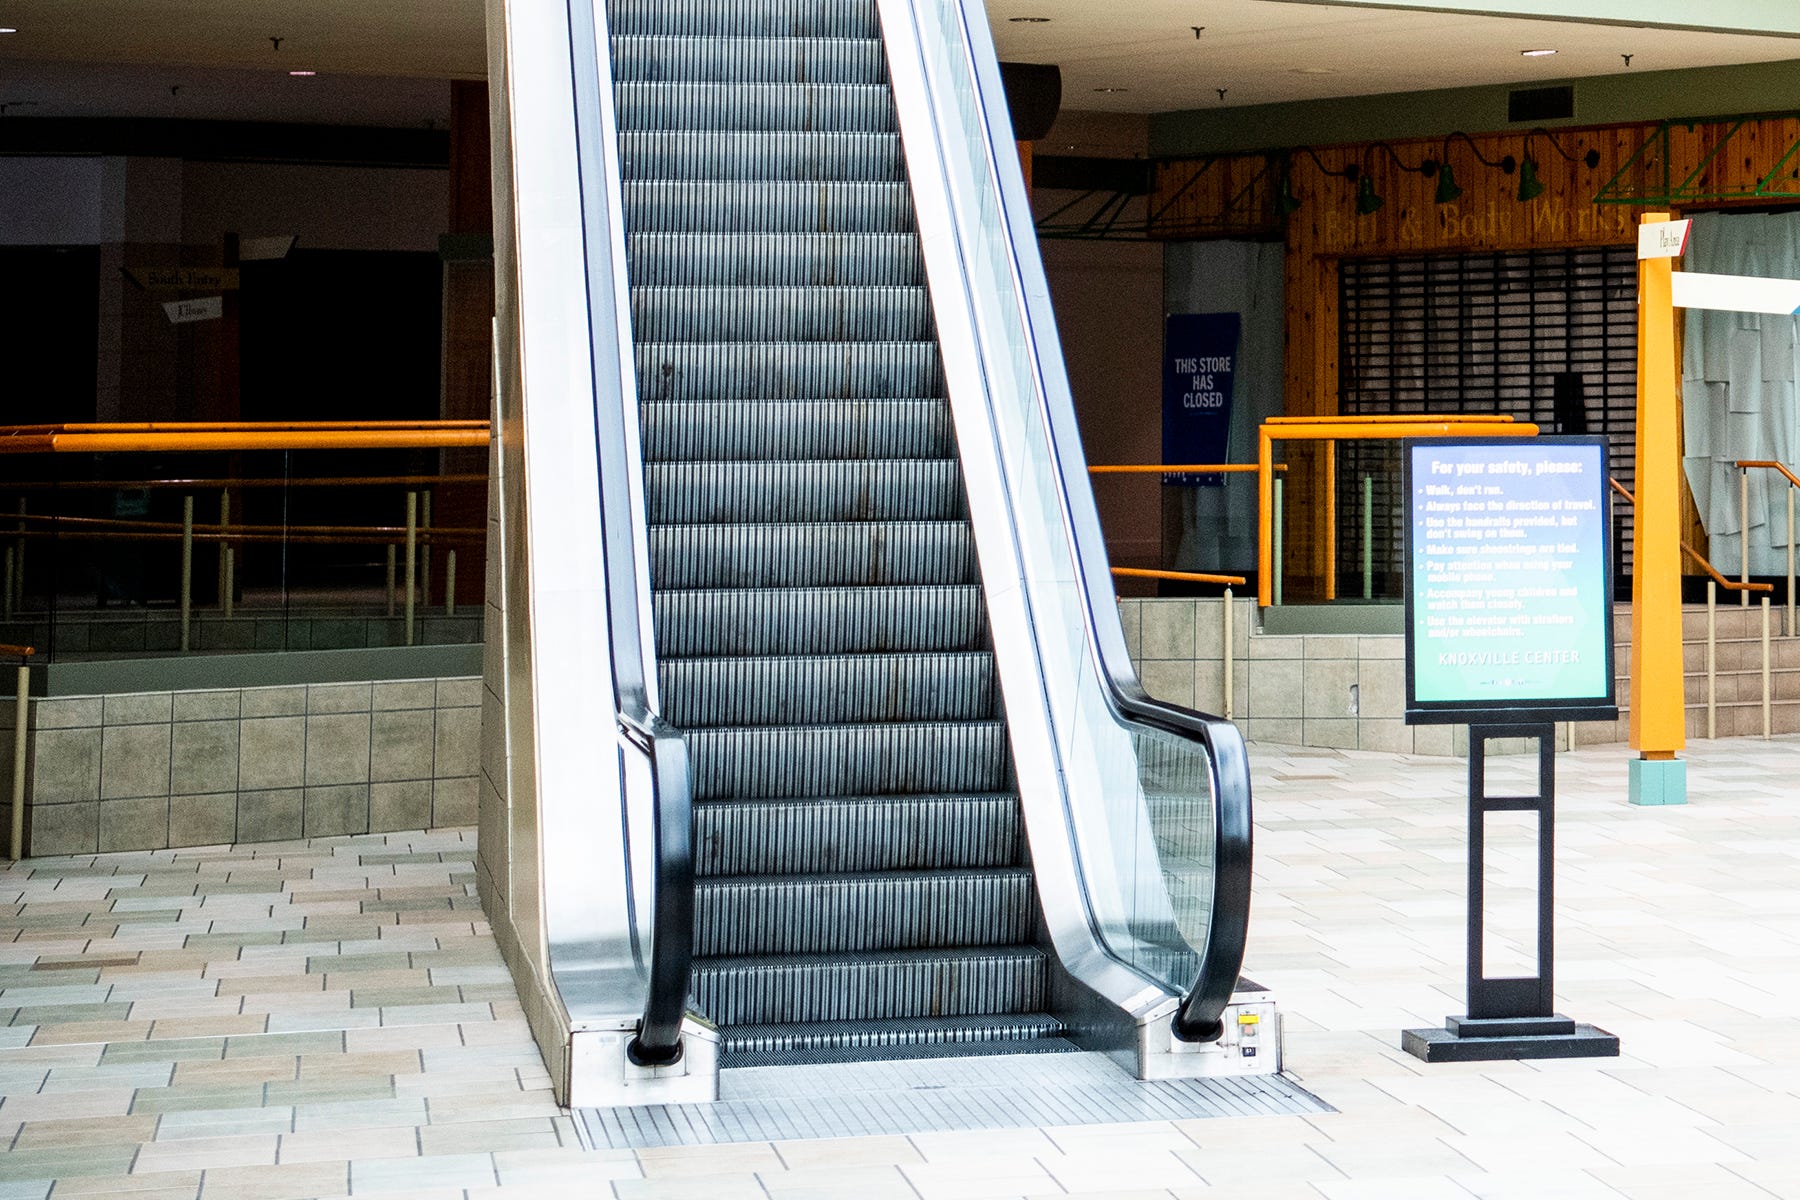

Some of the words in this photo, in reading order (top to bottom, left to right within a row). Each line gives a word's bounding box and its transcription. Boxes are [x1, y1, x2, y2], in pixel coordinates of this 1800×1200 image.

[1175, 359, 1197, 374] THIS
[1199, 356, 1232, 373] STORE
[1192, 375, 1214, 391] HAS
[1183, 392, 1223, 408] CLOSED
[1431, 460, 1454, 474] For
[1456, 463, 1484, 476] your
[1488, 460, 1532, 476] safety,
[1536, 460, 1583, 476] please:
[1426, 484, 1454, 496] Walk,
[1456, 485, 1482, 495] don't
[1426, 501, 1461, 513] Always
[1488, 500, 1503, 511] the
[1506, 500, 1550, 511] direction
[1551, 499, 1562, 510] of
[1426, 517, 1444, 528] Use
[1447, 516, 1463, 527] the
[1426, 560, 1444, 573] Pay
[1448, 616, 1464, 626] the
[1439, 651, 1521, 666] KNOXVILLE
[1524, 649, 1581, 664] CENTER
